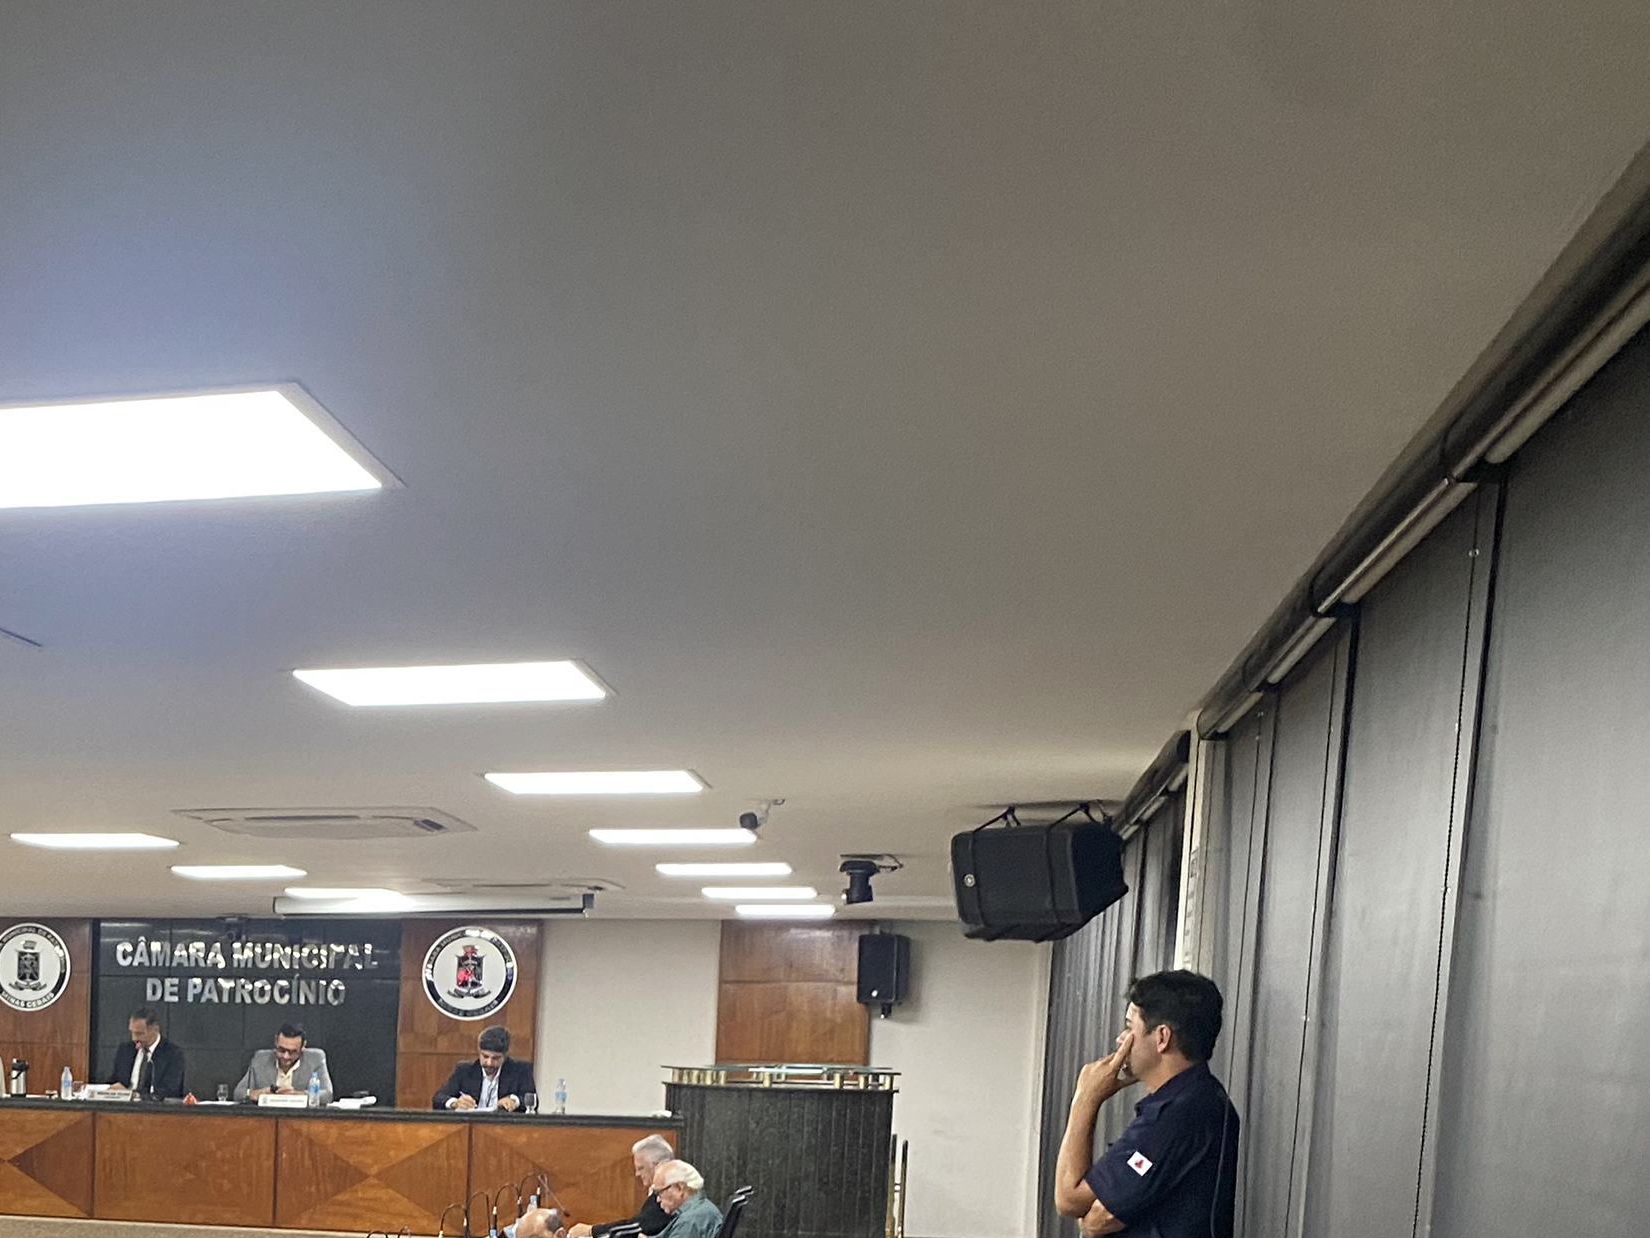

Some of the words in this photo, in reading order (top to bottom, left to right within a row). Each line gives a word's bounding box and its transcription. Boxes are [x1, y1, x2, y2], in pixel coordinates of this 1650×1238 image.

[116, 936, 226, 969] CÂMARA
[232, 942, 378, 969] MUNICIPAL
[146, 977, 179, 1002] DE
[187, 973, 345, 1006] PATROCÍNIO
